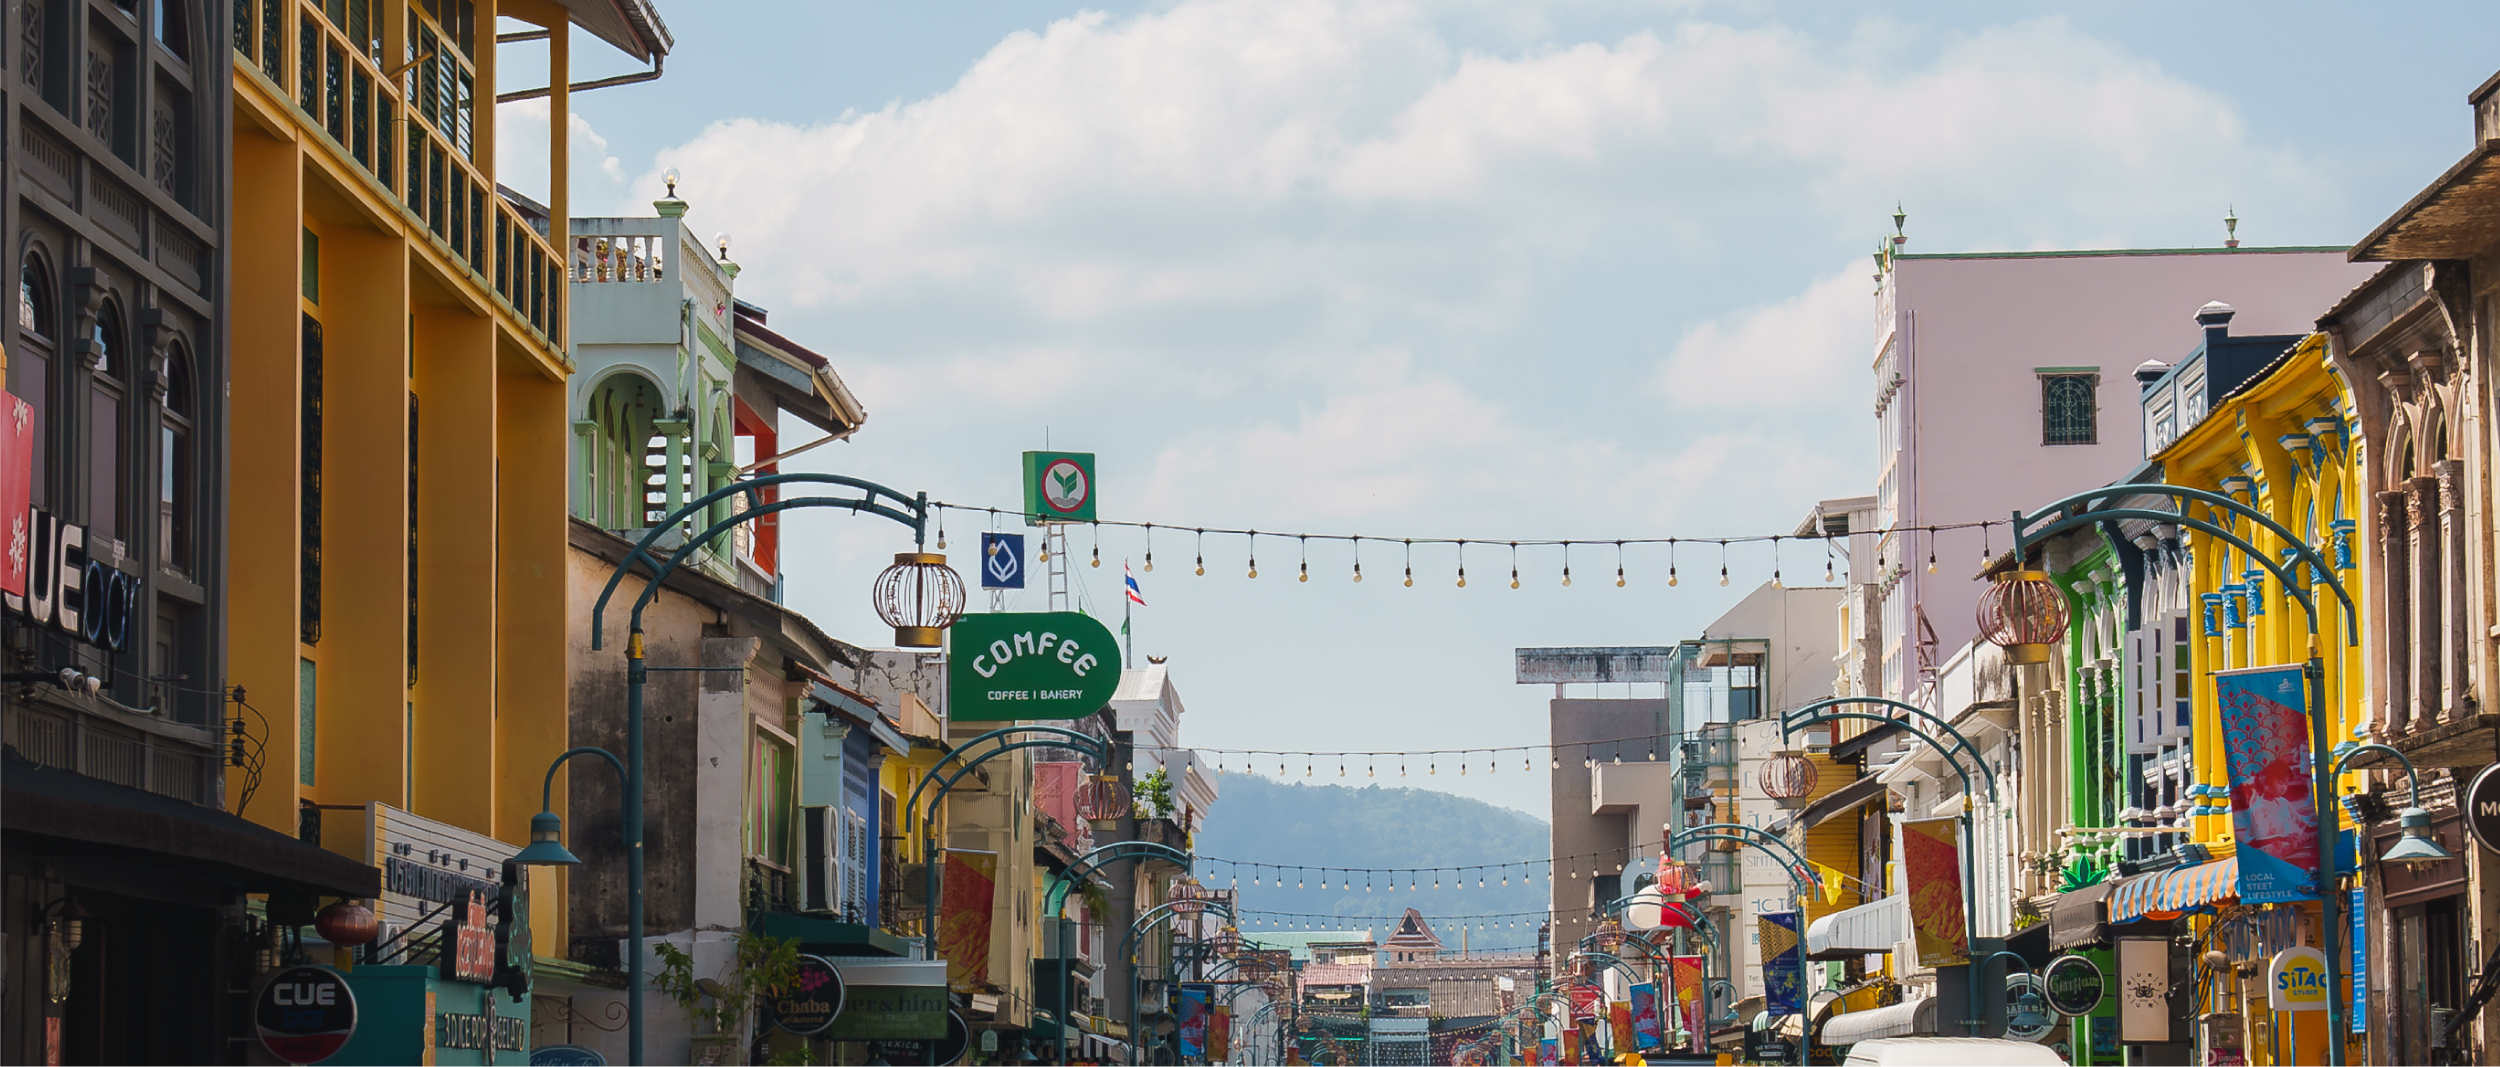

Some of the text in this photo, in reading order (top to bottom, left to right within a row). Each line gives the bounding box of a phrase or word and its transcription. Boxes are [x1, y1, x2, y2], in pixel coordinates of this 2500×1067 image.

[4, 506, 82, 634] UE
[972, 631, 1098, 679] COMFEE
[988, 690, 1029, 701] COFFEE
[1040, 689, 1084, 700] BAKERY
[2480, 801, 2500, 817] M
[2245, 873, 2276, 882] LOCAL
[2246, 882, 2274, 891] STEET
[2247, 890, 2293, 900] LIFESTYLE
[273, 983, 336, 1006] CUE
[776, 999, 831, 1015] Chaba
[898, 994, 943, 1012] him
[282, 1005, 326, 1028] bar
[861, 1014, 919, 1022] THAI TAILOR
[497, 1016, 526, 1053] GELATO
